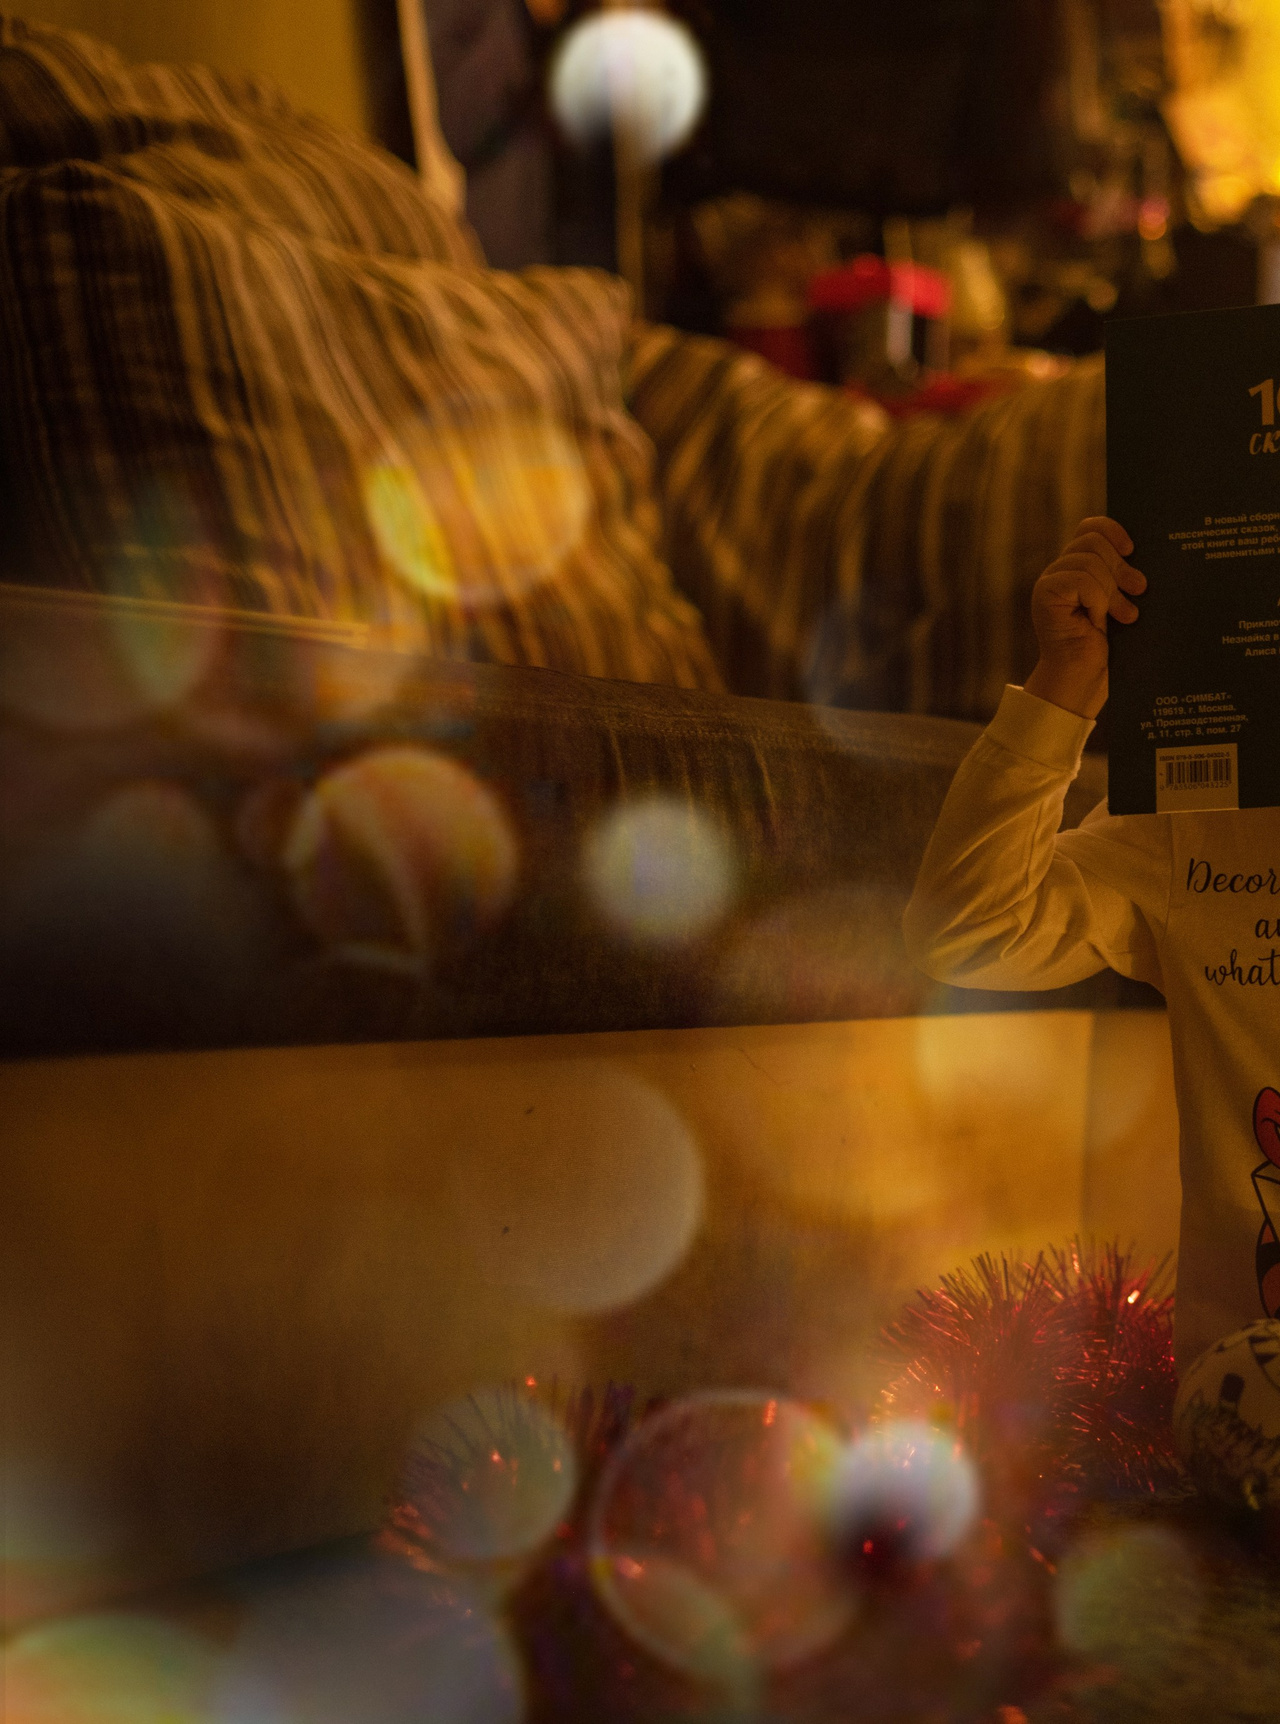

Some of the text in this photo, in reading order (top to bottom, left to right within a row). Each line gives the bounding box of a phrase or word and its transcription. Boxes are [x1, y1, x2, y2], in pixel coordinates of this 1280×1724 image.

[1204, 516, 1212, 526] В
[1214, 513, 1247, 525] новый
[1168, 527, 1238, 540] классических
[1181, 541, 1205, 551] этой
[1206, 538, 1236, 549] книге
[1237, 537, 1259, 546] ваш
[1204, 546, 1275, 560] знаменитыми
[1221, 632, 1271, 645] Незнайка
[1273, 633, 1279, 641] в
[1244, 646, 1276, 657] Алиса
[1155, 695, 1179, 706] ООО
[1230, 723, 1241, 733] 27
